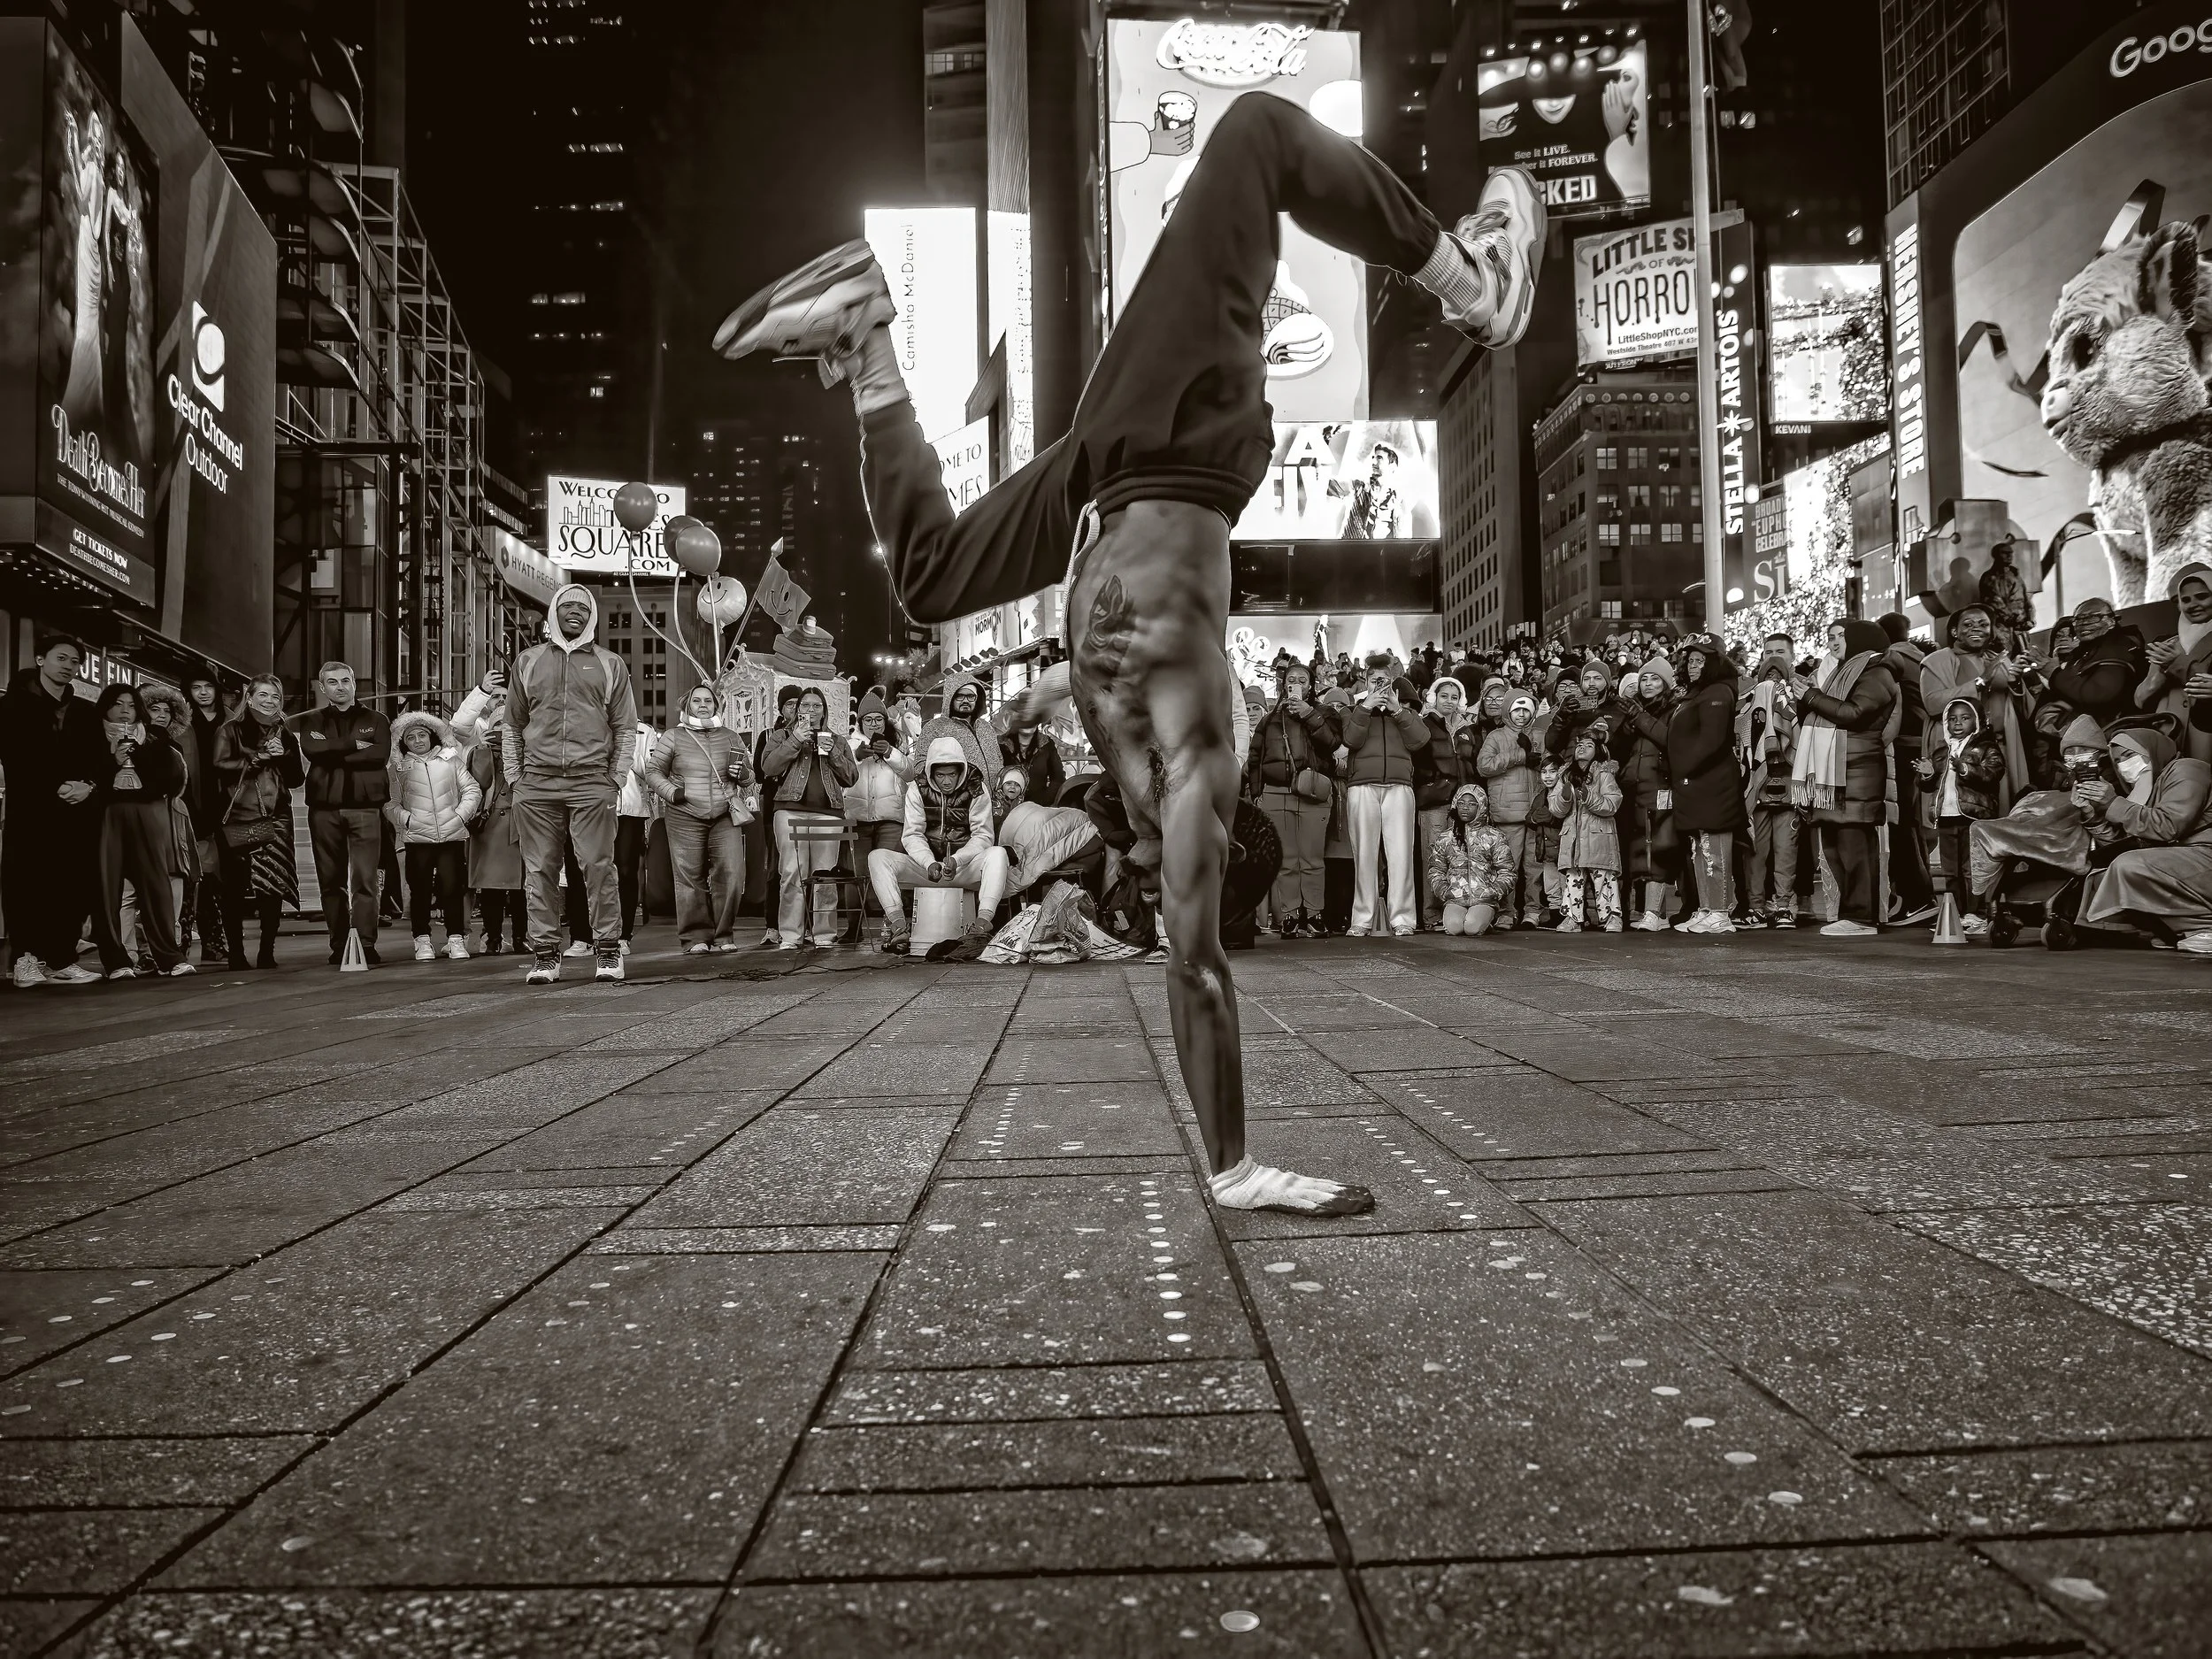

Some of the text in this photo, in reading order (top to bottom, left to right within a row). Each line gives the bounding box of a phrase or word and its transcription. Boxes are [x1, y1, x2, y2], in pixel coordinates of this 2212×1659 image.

[1543, 143, 1571, 157] LIVE.
[1548, 151, 1599, 168] FOREVER.
[1593, 228, 1668, 280] LITTLE
[1648, 257, 1665, 269] OF
[1593, 268, 1697, 346] HORRO
[1606, 345, 1636, 357] Westside
[1637, 342, 1662, 352] Theatre
[1893, 223, 1925, 480] HERSHEY'S STORE
[167, 373, 243, 471] Clear Channel
[1717, 310, 1744, 536] STELLA ARTOIS
[1774, 425, 1812, 435] KEVANI
[186, 432, 228, 495] Outdoor
[965, 443, 982, 464] TO
[73, 527, 128, 570] GET TICKETS NOW
[558, 525, 670, 559] SQUARE
[511, 555, 536, 580] HYATT
[625, 558, 671, 572] .COM
[975, 611, 1002, 636] MORMON
